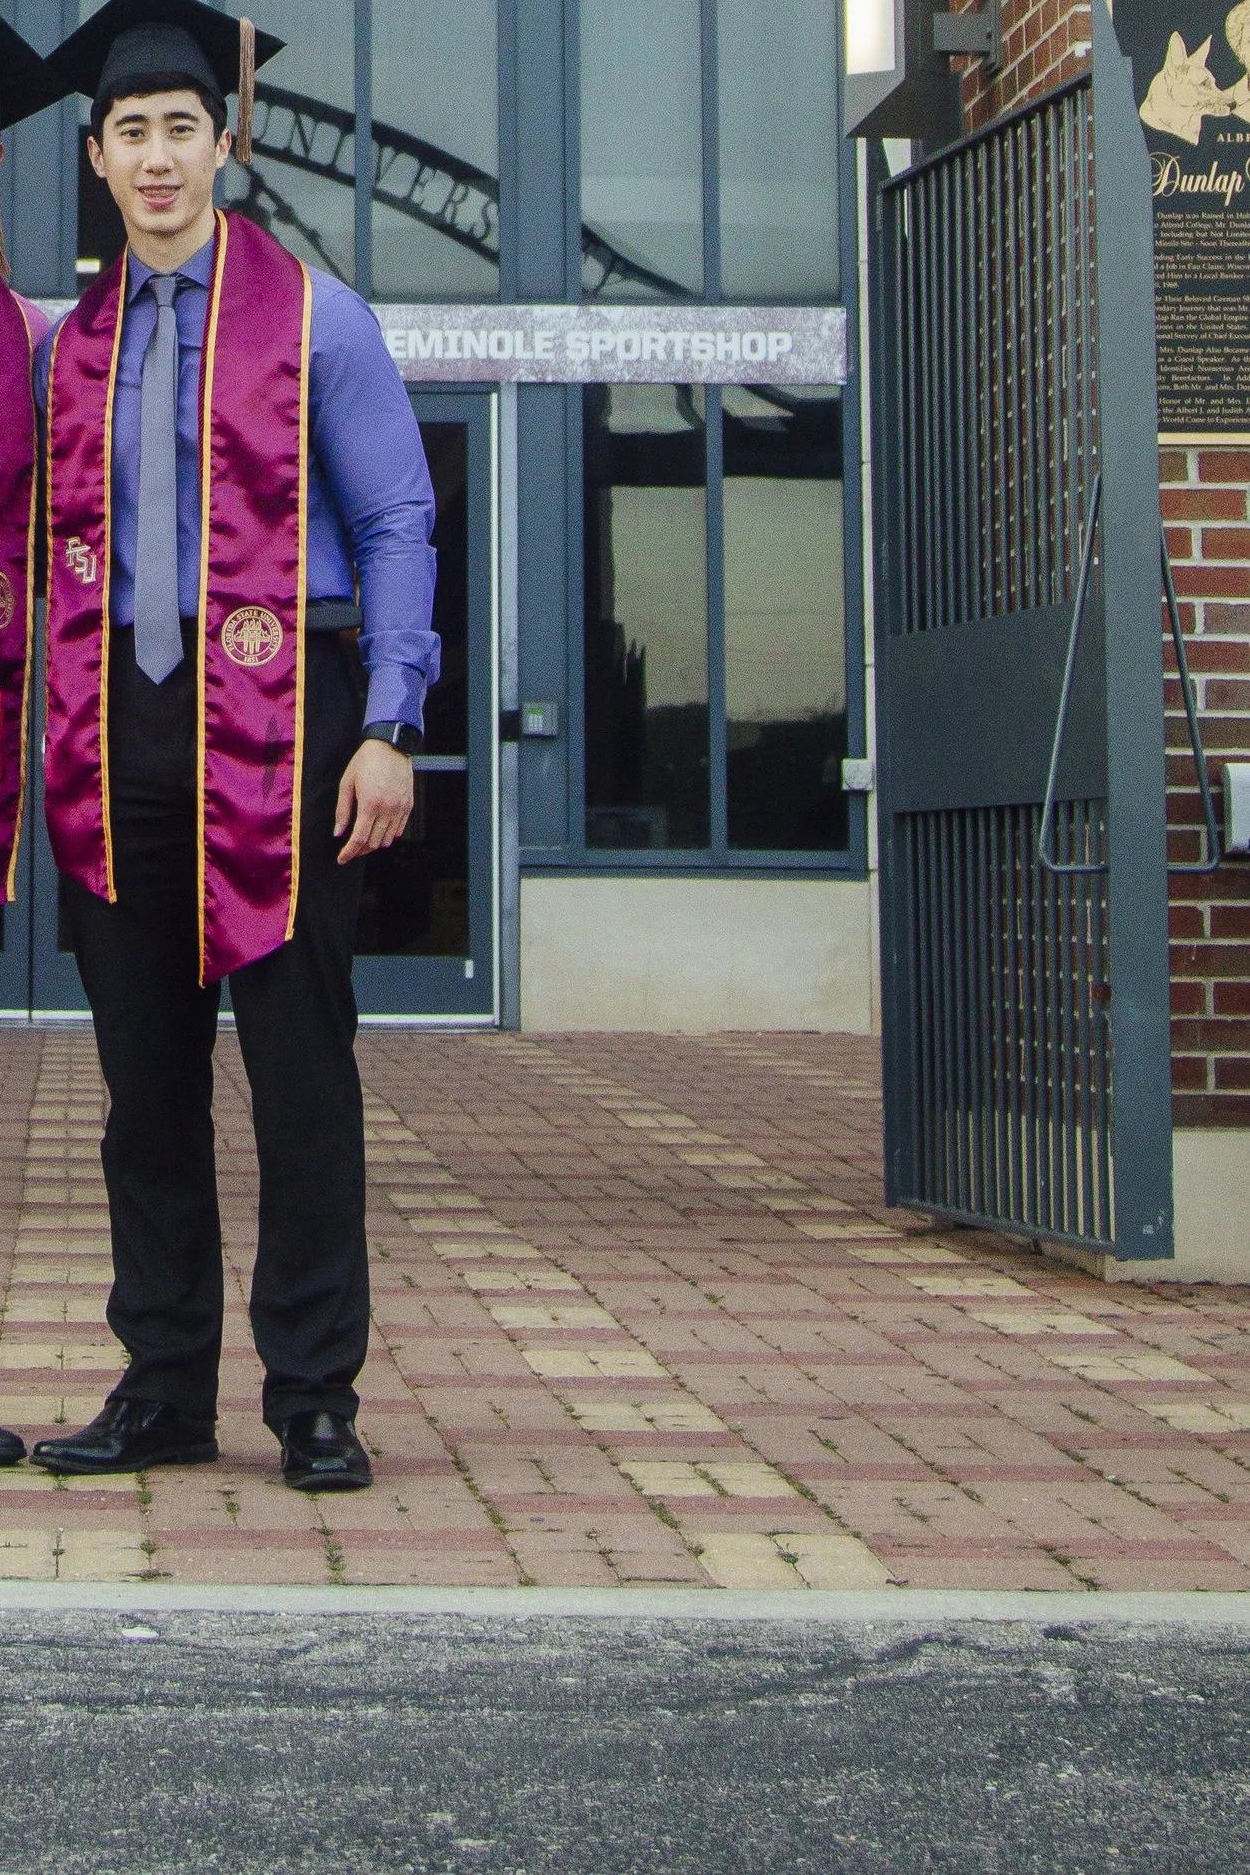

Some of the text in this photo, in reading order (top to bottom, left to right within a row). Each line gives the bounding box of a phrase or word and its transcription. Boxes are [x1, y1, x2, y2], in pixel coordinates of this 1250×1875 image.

[1150, 151, 1245, 206] Dunlap
[384, 329, 793, 362] EMINOLE SPORTSHOP
[66, 536, 97, 584] FSU
[236, 609, 259, 620] STATE
